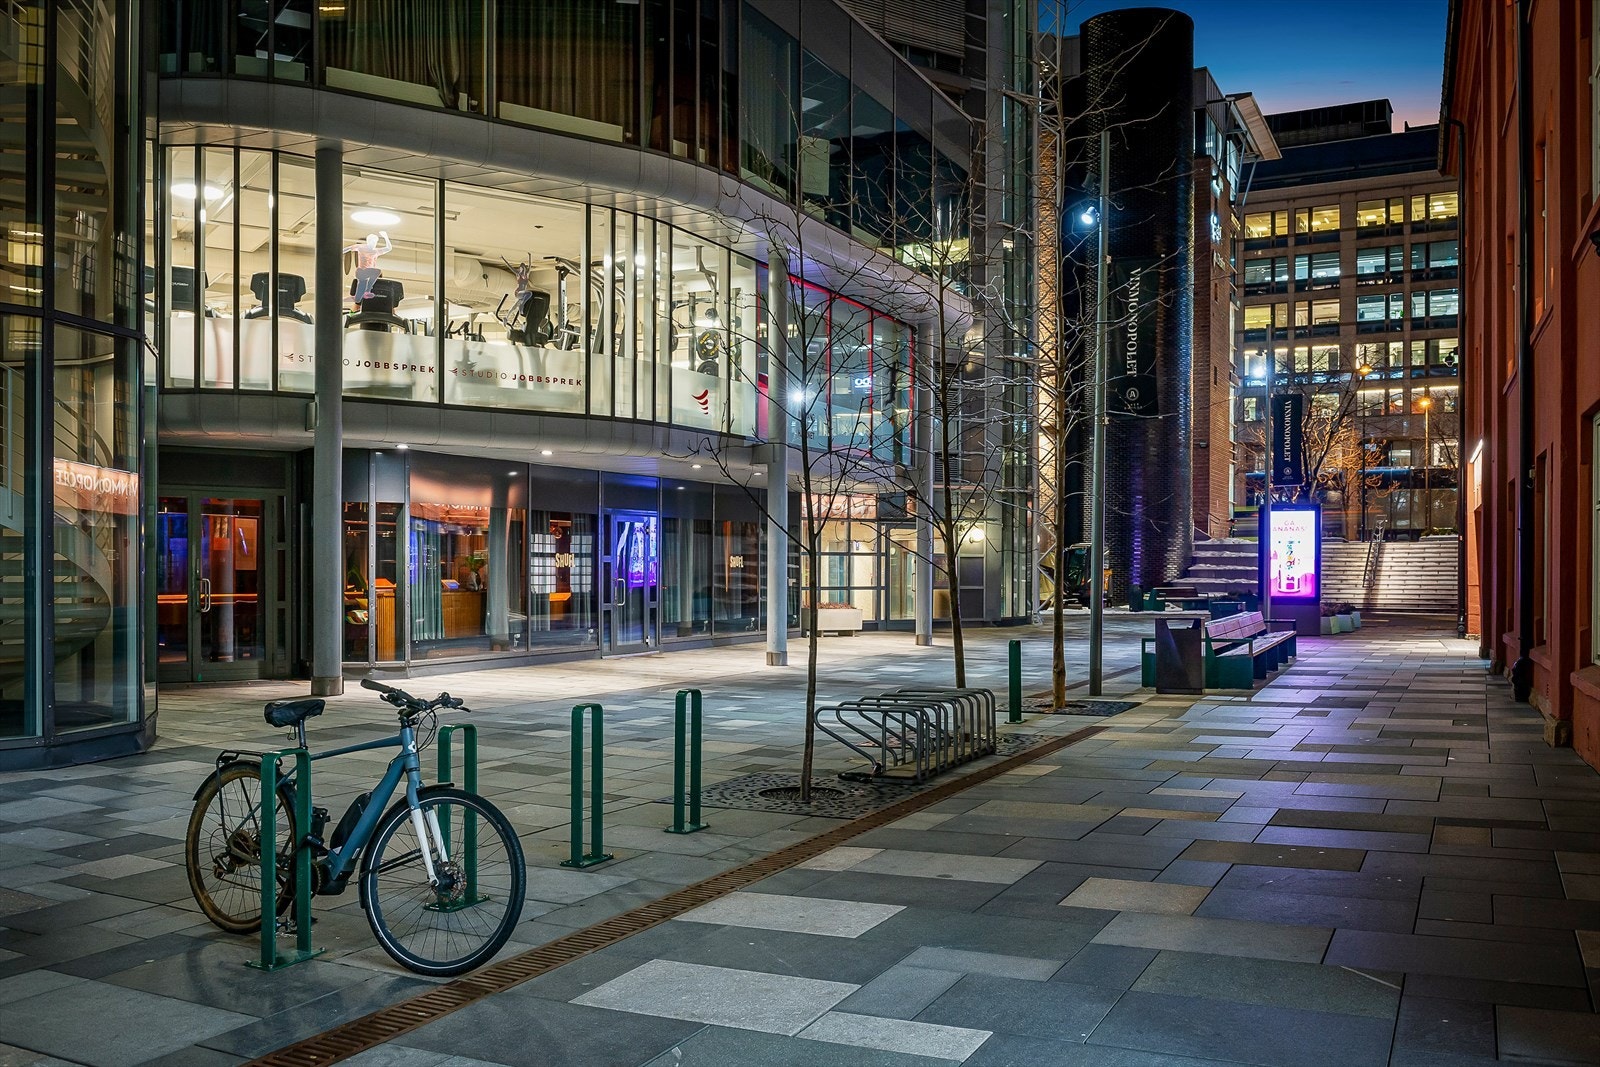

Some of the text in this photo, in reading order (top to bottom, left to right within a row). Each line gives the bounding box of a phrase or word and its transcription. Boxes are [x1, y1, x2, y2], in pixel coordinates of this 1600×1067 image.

[1126, 267, 1141, 377] VINMONOPOLET
[298, 354, 435, 374] STO JOBBSPREK
[461, 369, 583, 387] STUDIO JOBBSPREK
[1283, 400, 1292, 462] VINMONOPOLET
